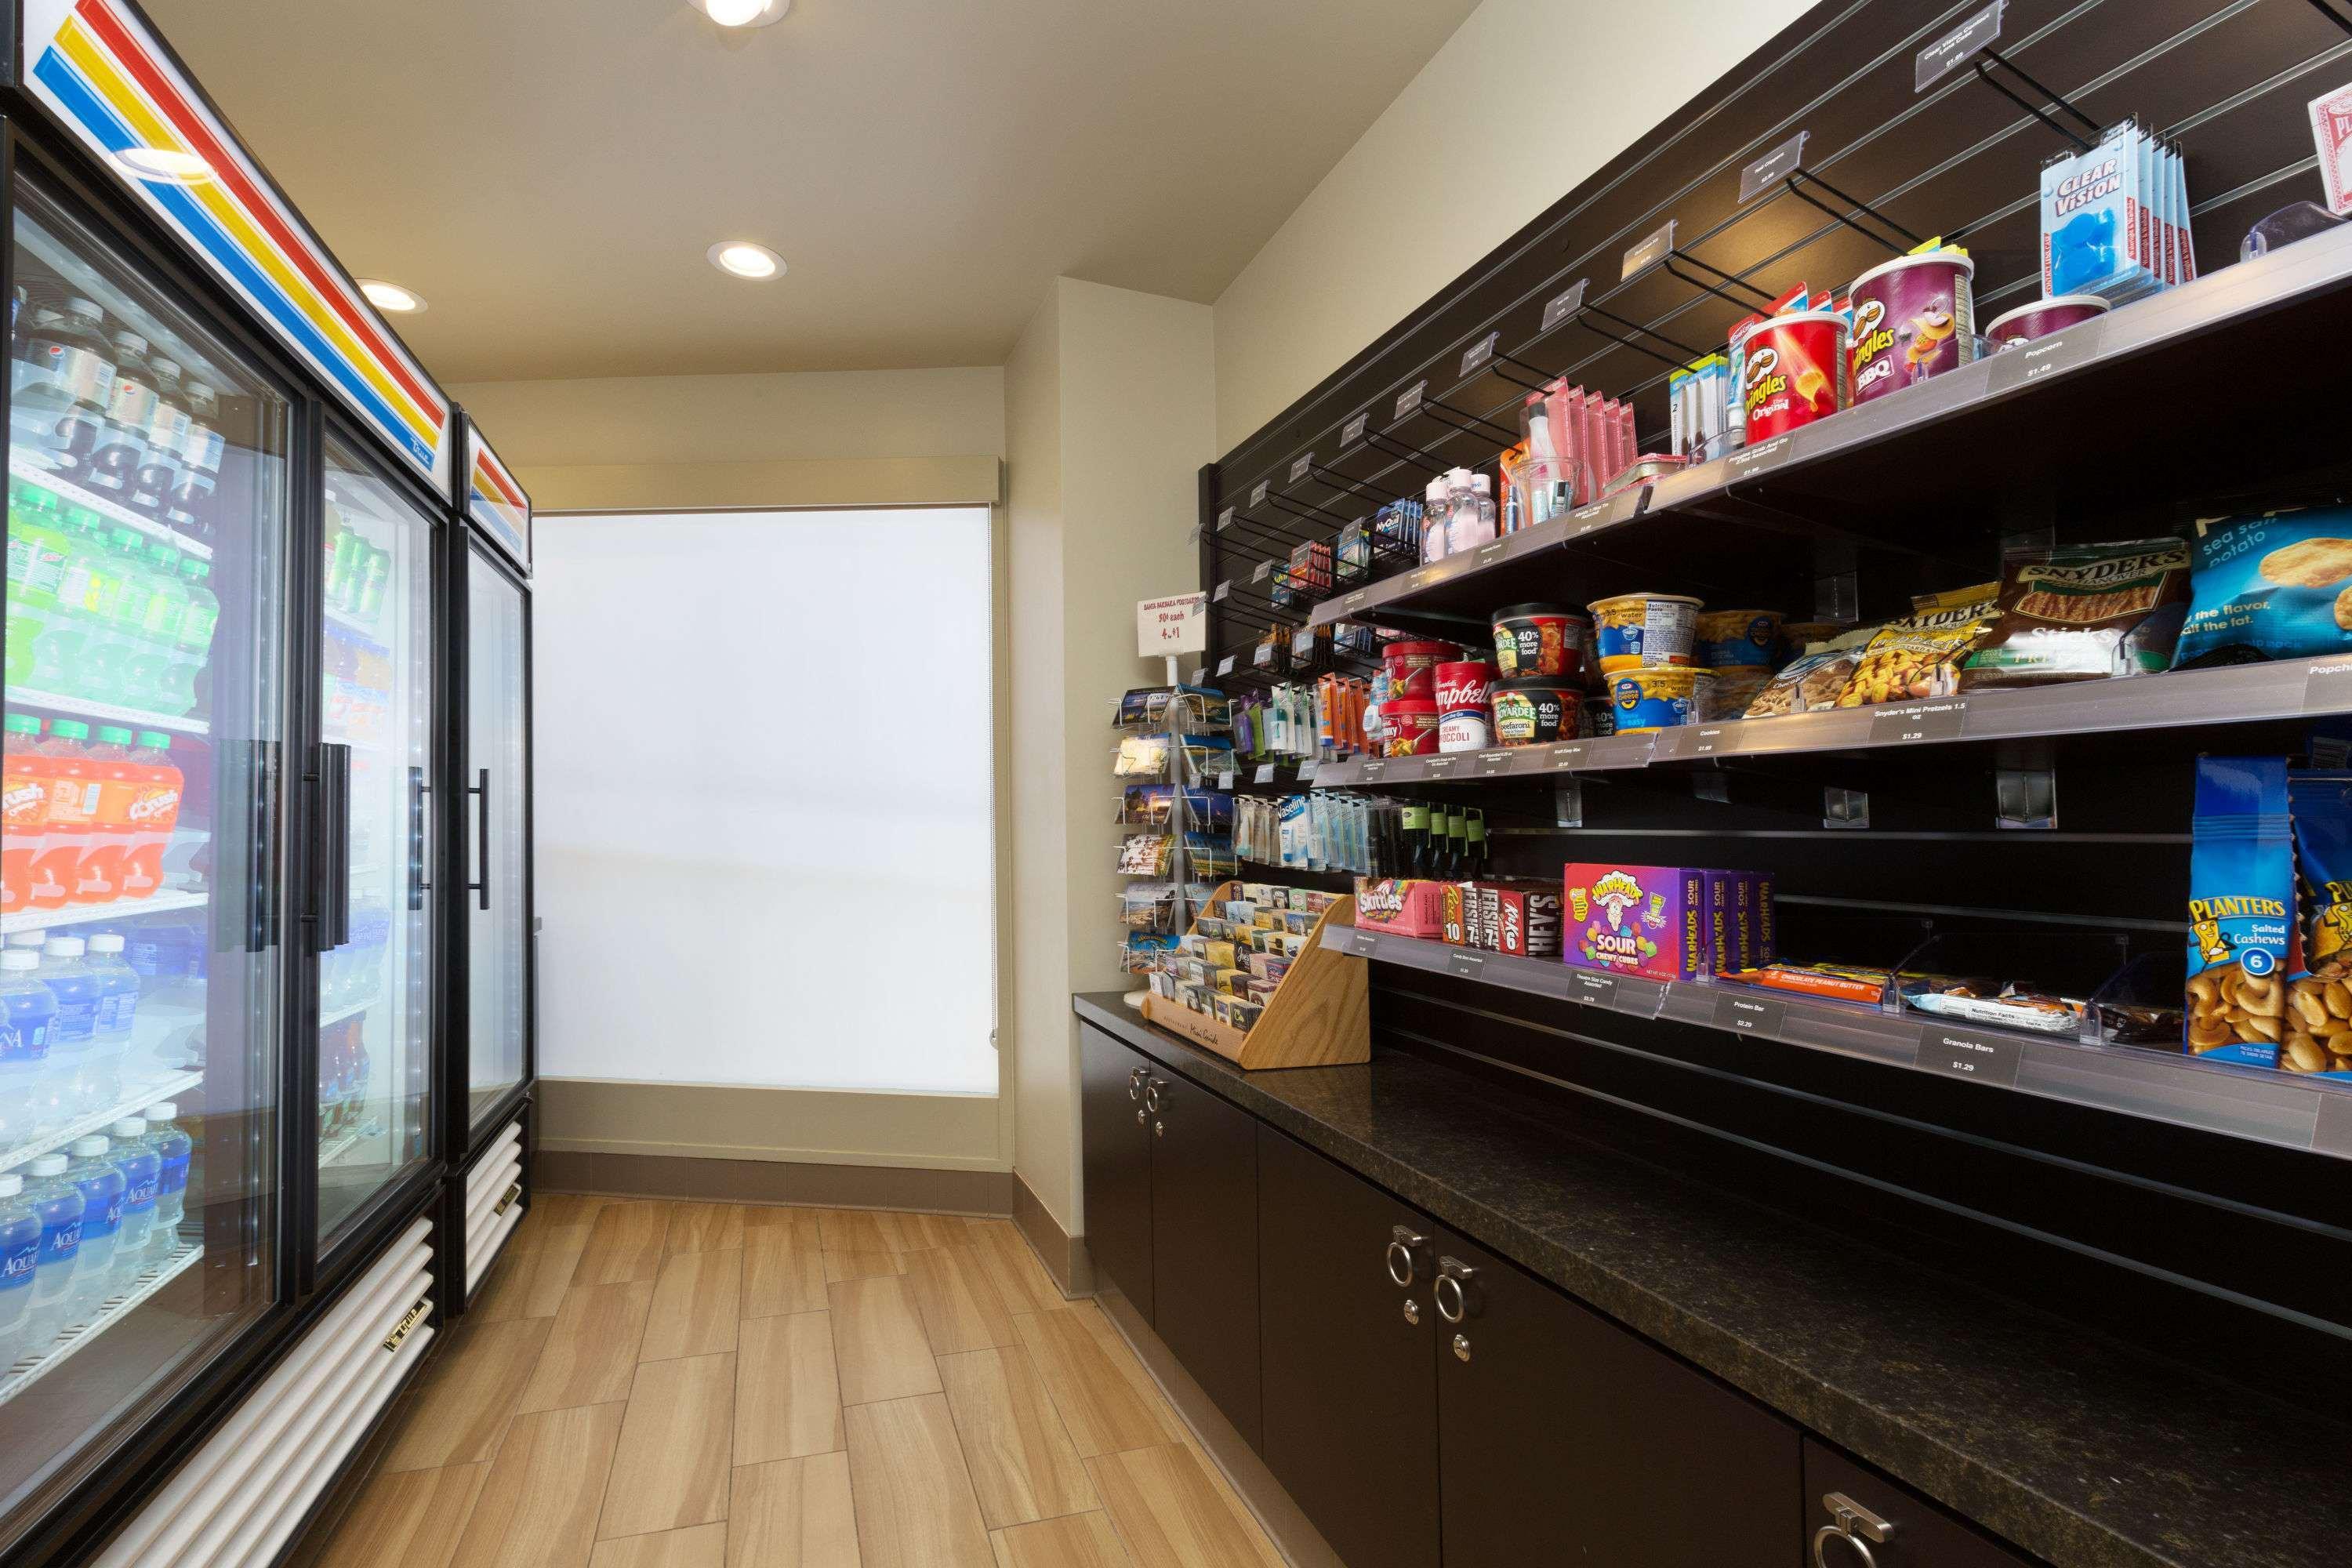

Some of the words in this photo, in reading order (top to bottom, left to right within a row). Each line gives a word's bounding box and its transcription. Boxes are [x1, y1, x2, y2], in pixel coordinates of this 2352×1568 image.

[2056, 158, 2118, 197] CLEAR
[2024, 340, 2063, 359] Popcorn
[1856, 359, 1892, 392] BBQ
[1752, 398, 1790, 421] Original
[1376, 514, 1400, 532] NyQuil
[2203, 531, 2233, 556] sea
[2208, 531, 2266, 568] potato
[1170, 611, 1185, 622] each
[2195, 608, 2219, 621] the
[2223, 601, 2270, 615] flavor,
[2180, 622, 2200, 636] alf
[2203, 620, 2227, 631] the
[2230, 615, 2253, 627] fat.
[1518, 630, 1539, 642] 40%
[1538, 702, 1560, 713] 40%
[1874, 708, 1905, 718] Snyder's
[1922, 703, 1953, 713] Pretzels
[1954, 702, 1965, 710] 1.5
[1901, 732, 1922, 741] $1.29
[1592, 877, 1643, 904] WARHEADS
[2188, 896, 2286, 923] PLANTERS
[1446, 922, 1460, 941] 10
[1466, 925, 1475, 943] 7
[1485, 928, 1494, 947] 7
[2251, 924, 2285, 934] Salted
[1506, 931, 1516, 950] 6
[1596, 934, 1637, 956] SOUR
[1686, 909, 1697, 972] WARHEADS
[1714, 910, 1726, 972] WARHEADS
[2234, 933, 2285, 946] Cashews
[1595, 952, 1617, 962] CHEWY
[1618, 955, 1639, 965] CUBES
[2249, 955, 2263, 968] 6
[1599, 978, 1613, 986] Candy
[1780, 974, 1816, 984] CHOCOLATE
[1816, 978, 1839, 987] PEANUT
[1839, 981, 1865, 990] BUTTER
[1733, 1000, 1751, 1011] Protein
[1751, 1003, 1765, 1012] Bar
[1971, 1007, 1998, 1017] Nutrition
[1737, 1020, 1752, 1029] $2.29
[1942, 1037, 1974, 1050] Granola
[1974, 1043, 1994, 1054] Bars
[1951, 1061, 1975, 1072] $1.29
